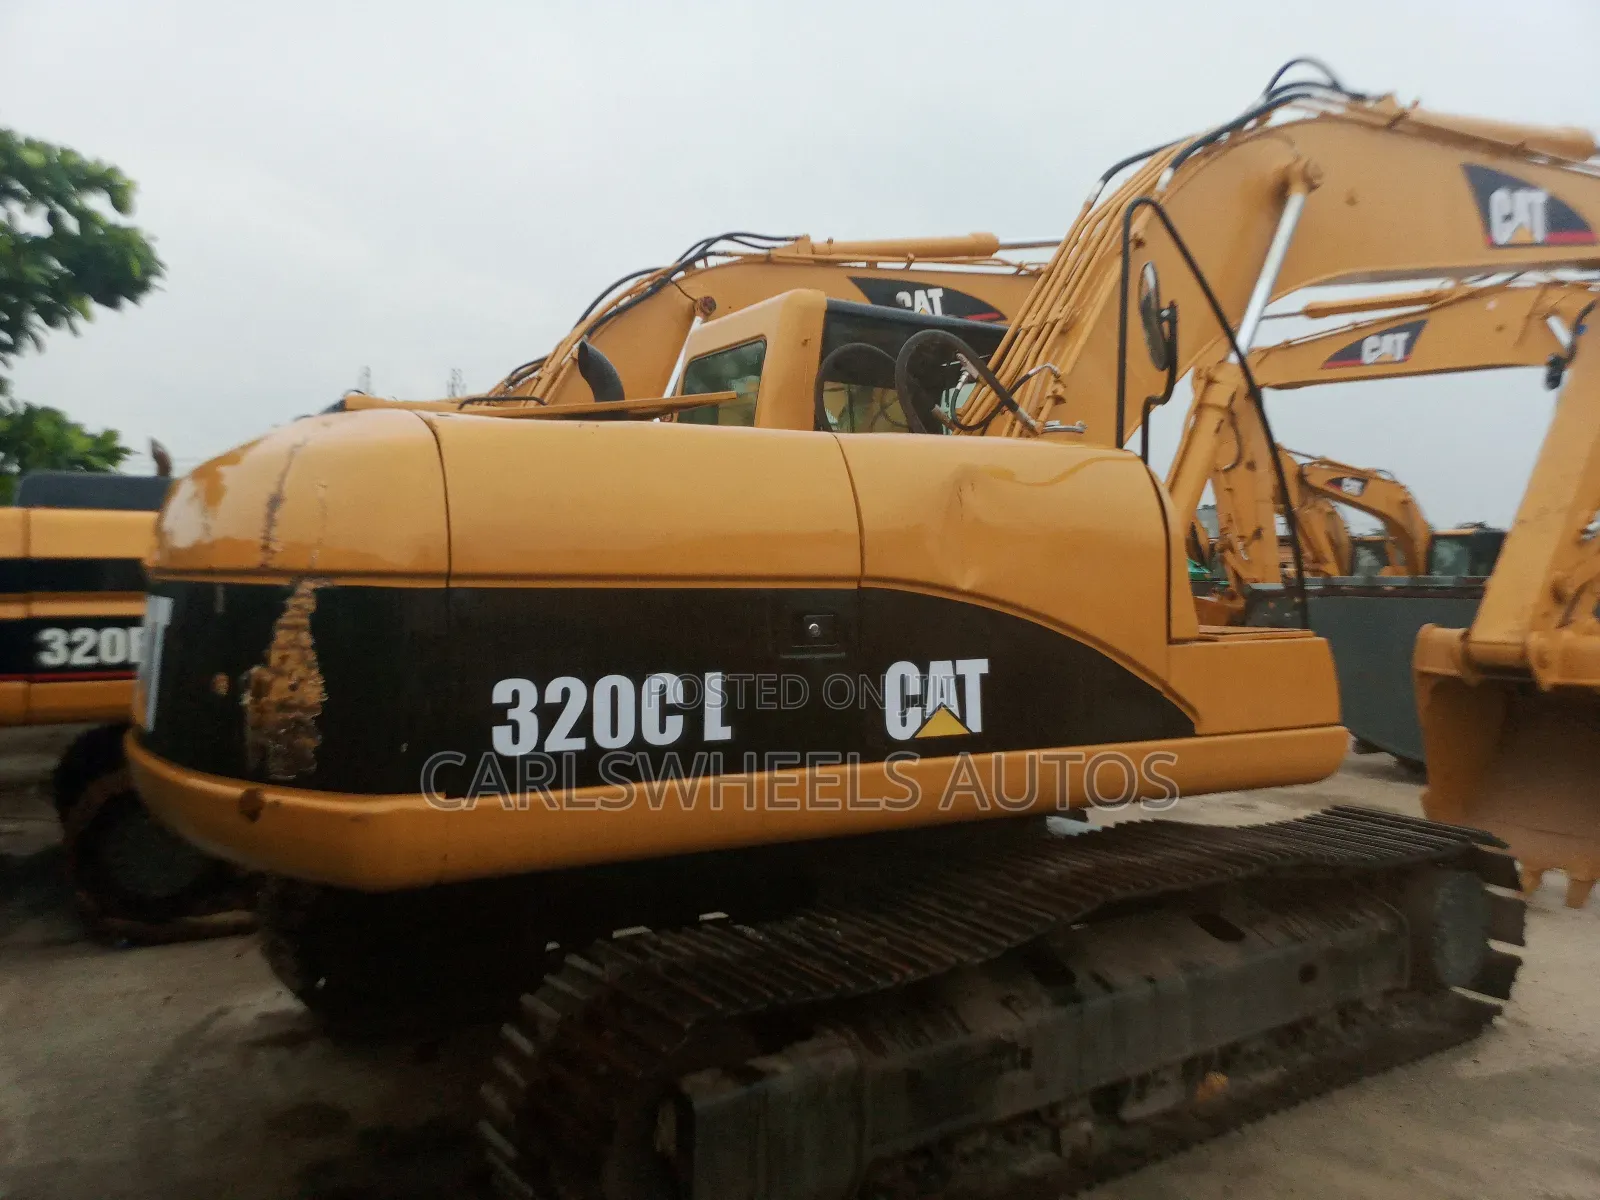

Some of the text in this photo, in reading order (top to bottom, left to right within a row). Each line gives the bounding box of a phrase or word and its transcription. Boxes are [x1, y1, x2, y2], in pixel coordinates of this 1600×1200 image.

[1489, 187, 1547, 245] CAT
[1361, 331, 1410, 365] CAT
[491, 671, 732, 757] 320C L
[885, 659, 989, 741] CAT
